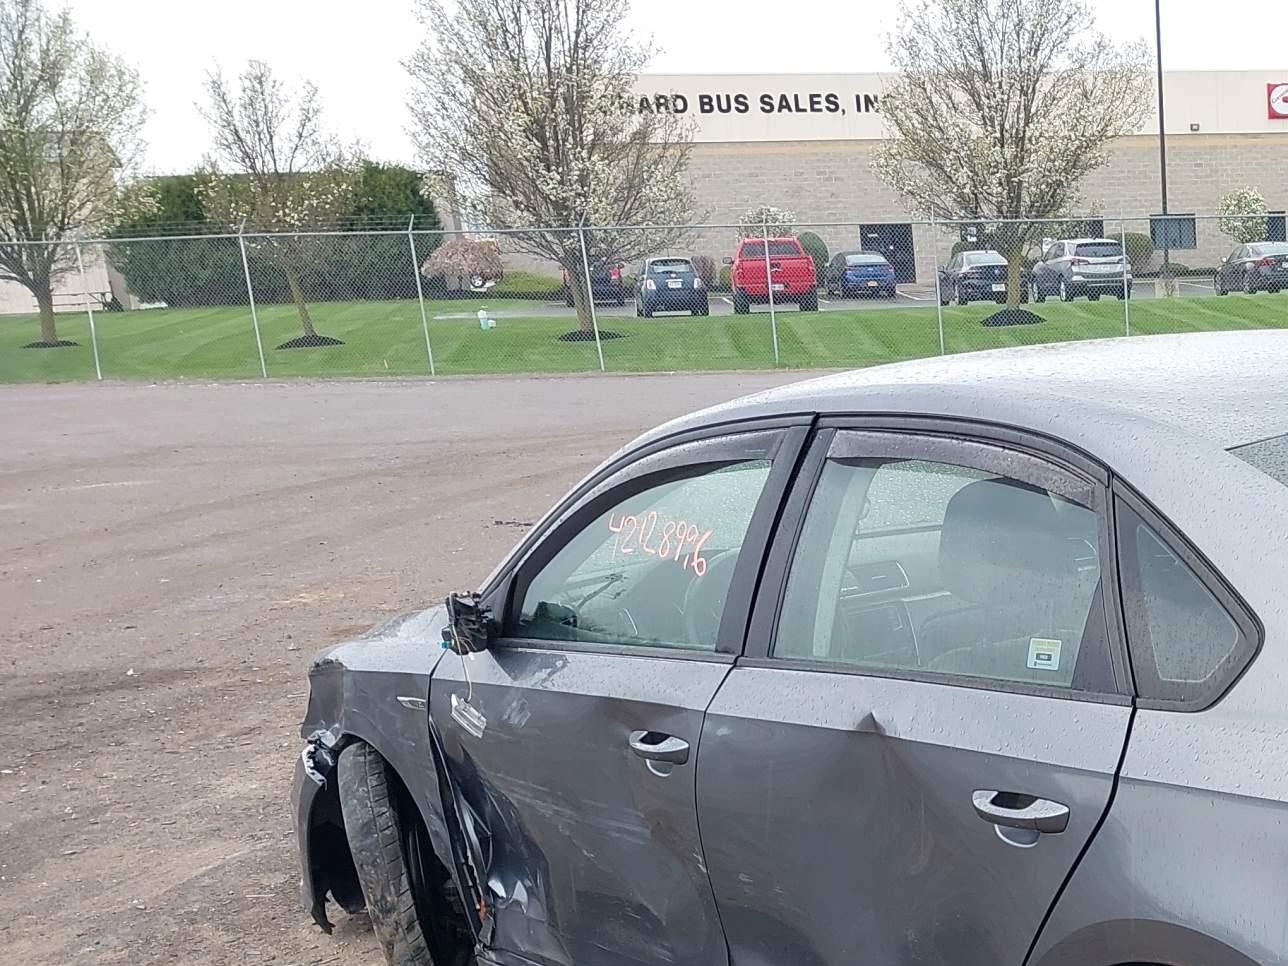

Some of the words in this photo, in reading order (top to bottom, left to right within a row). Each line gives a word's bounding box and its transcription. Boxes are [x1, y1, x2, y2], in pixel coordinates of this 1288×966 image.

[631, 93, 689, 115] ARD
[698, 93, 749, 114] BUS
[759, 92, 846, 116] SALES,
[855, 94, 883, 113] IN
